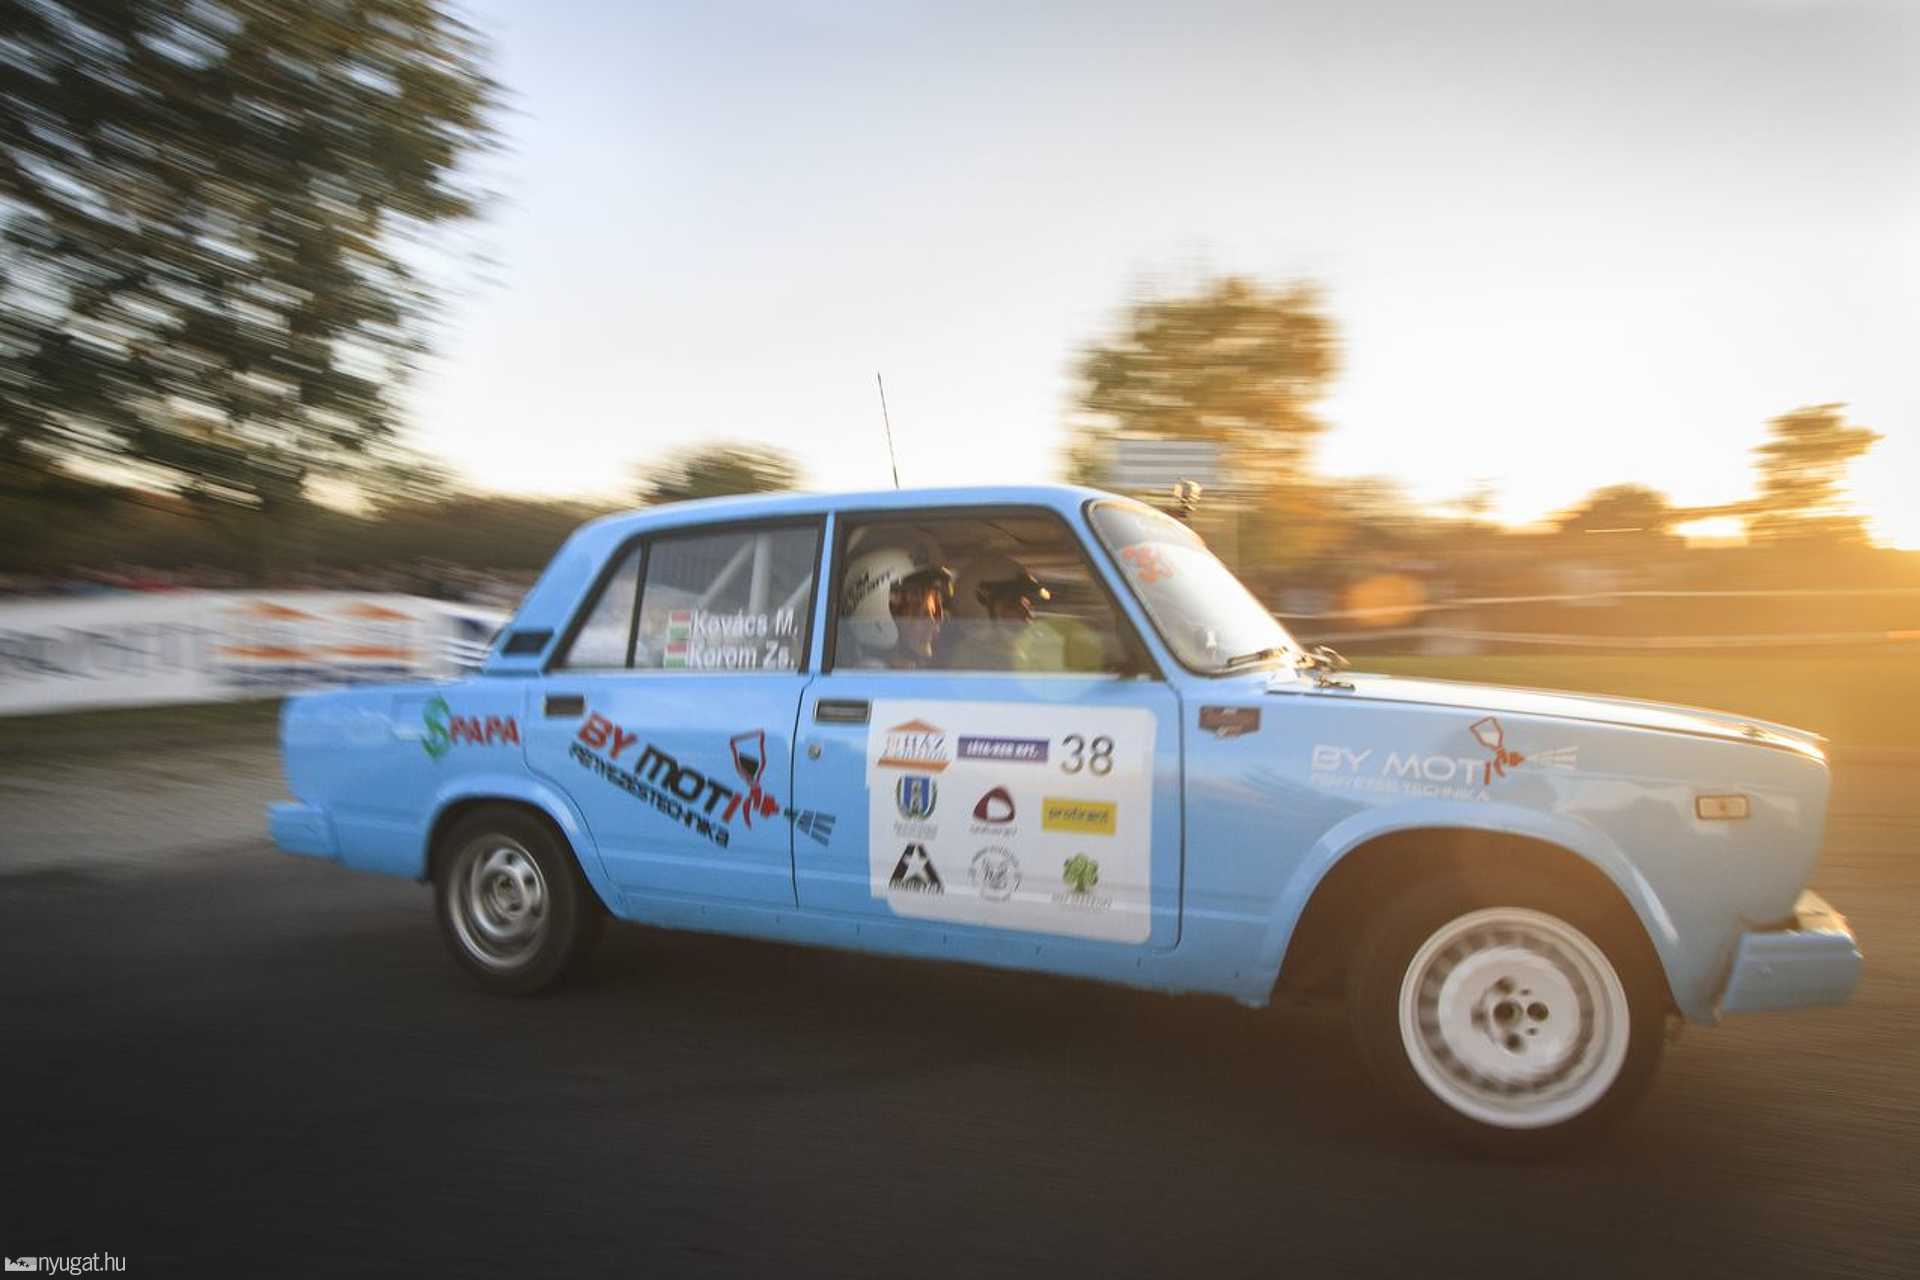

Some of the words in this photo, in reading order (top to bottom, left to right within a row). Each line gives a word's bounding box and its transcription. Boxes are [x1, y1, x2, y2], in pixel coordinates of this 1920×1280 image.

[687, 608, 769, 638] Kovács
[775, 606, 799, 636] M.
[687, 640, 758, 669] Korom
[578, 711, 638, 760] BY
[1060, 734, 1114, 776] 38
[1312, 744, 1375, 773] BY
